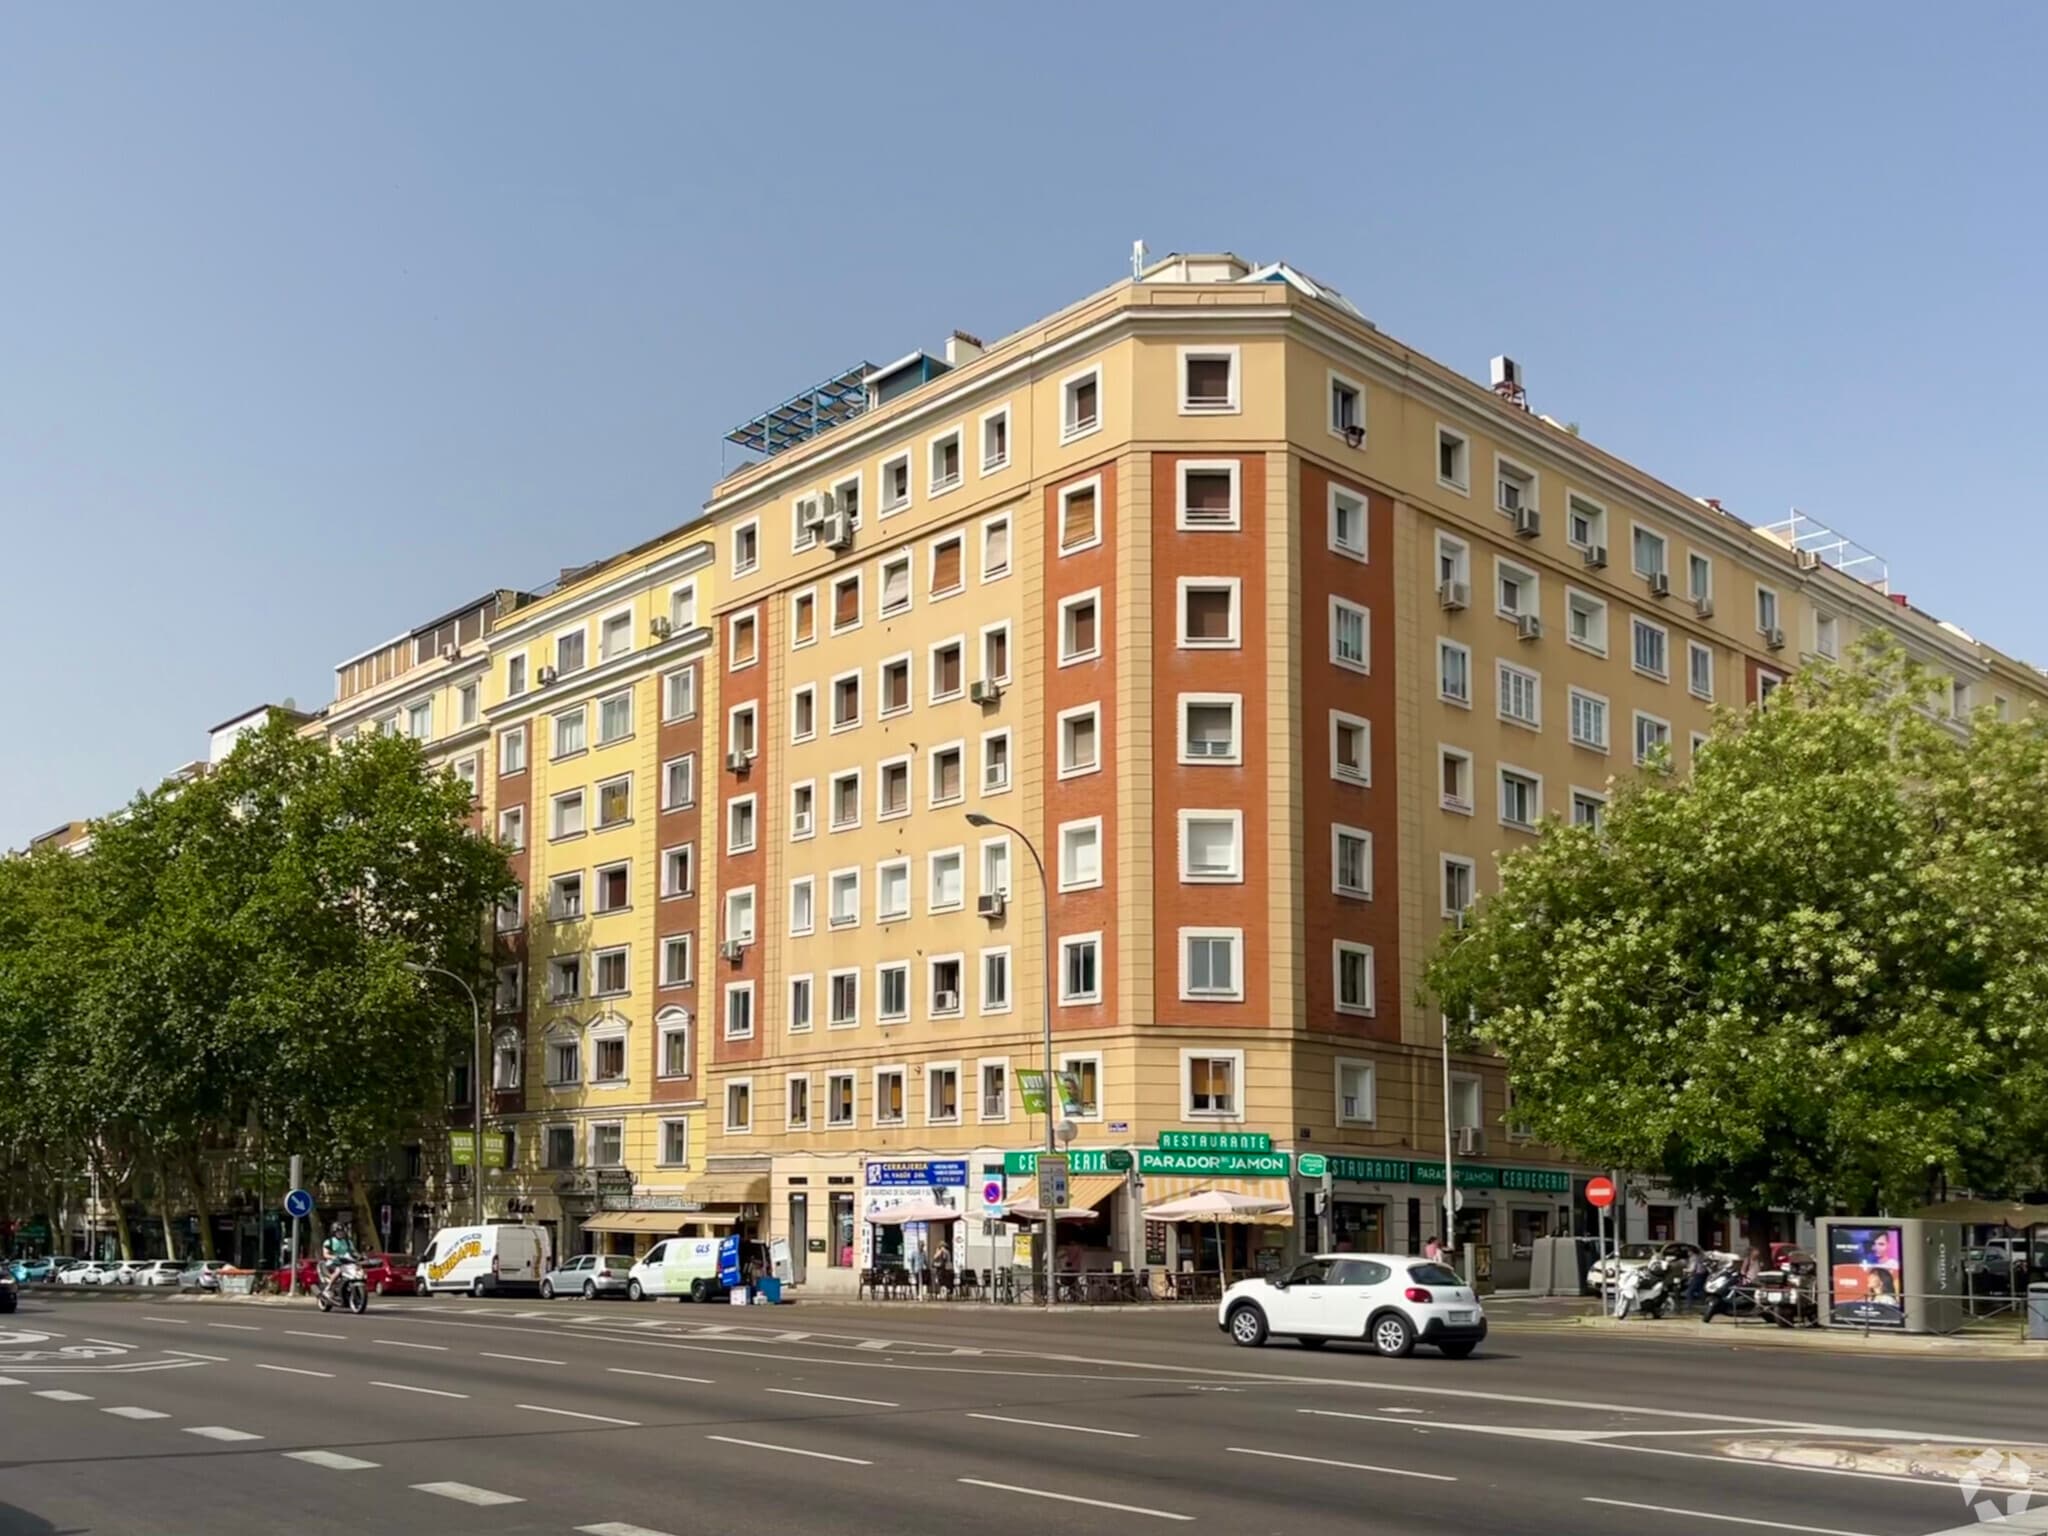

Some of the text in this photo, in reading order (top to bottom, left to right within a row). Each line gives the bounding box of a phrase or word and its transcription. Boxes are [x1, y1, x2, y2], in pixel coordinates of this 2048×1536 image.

[1163, 1134, 1265, 1149] RESTAURANTE
[1143, 1155, 1220, 1169] PARADOR
[1229, 1157, 1284, 1170] JAMON
[695, 1243, 710, 1254] GLS
